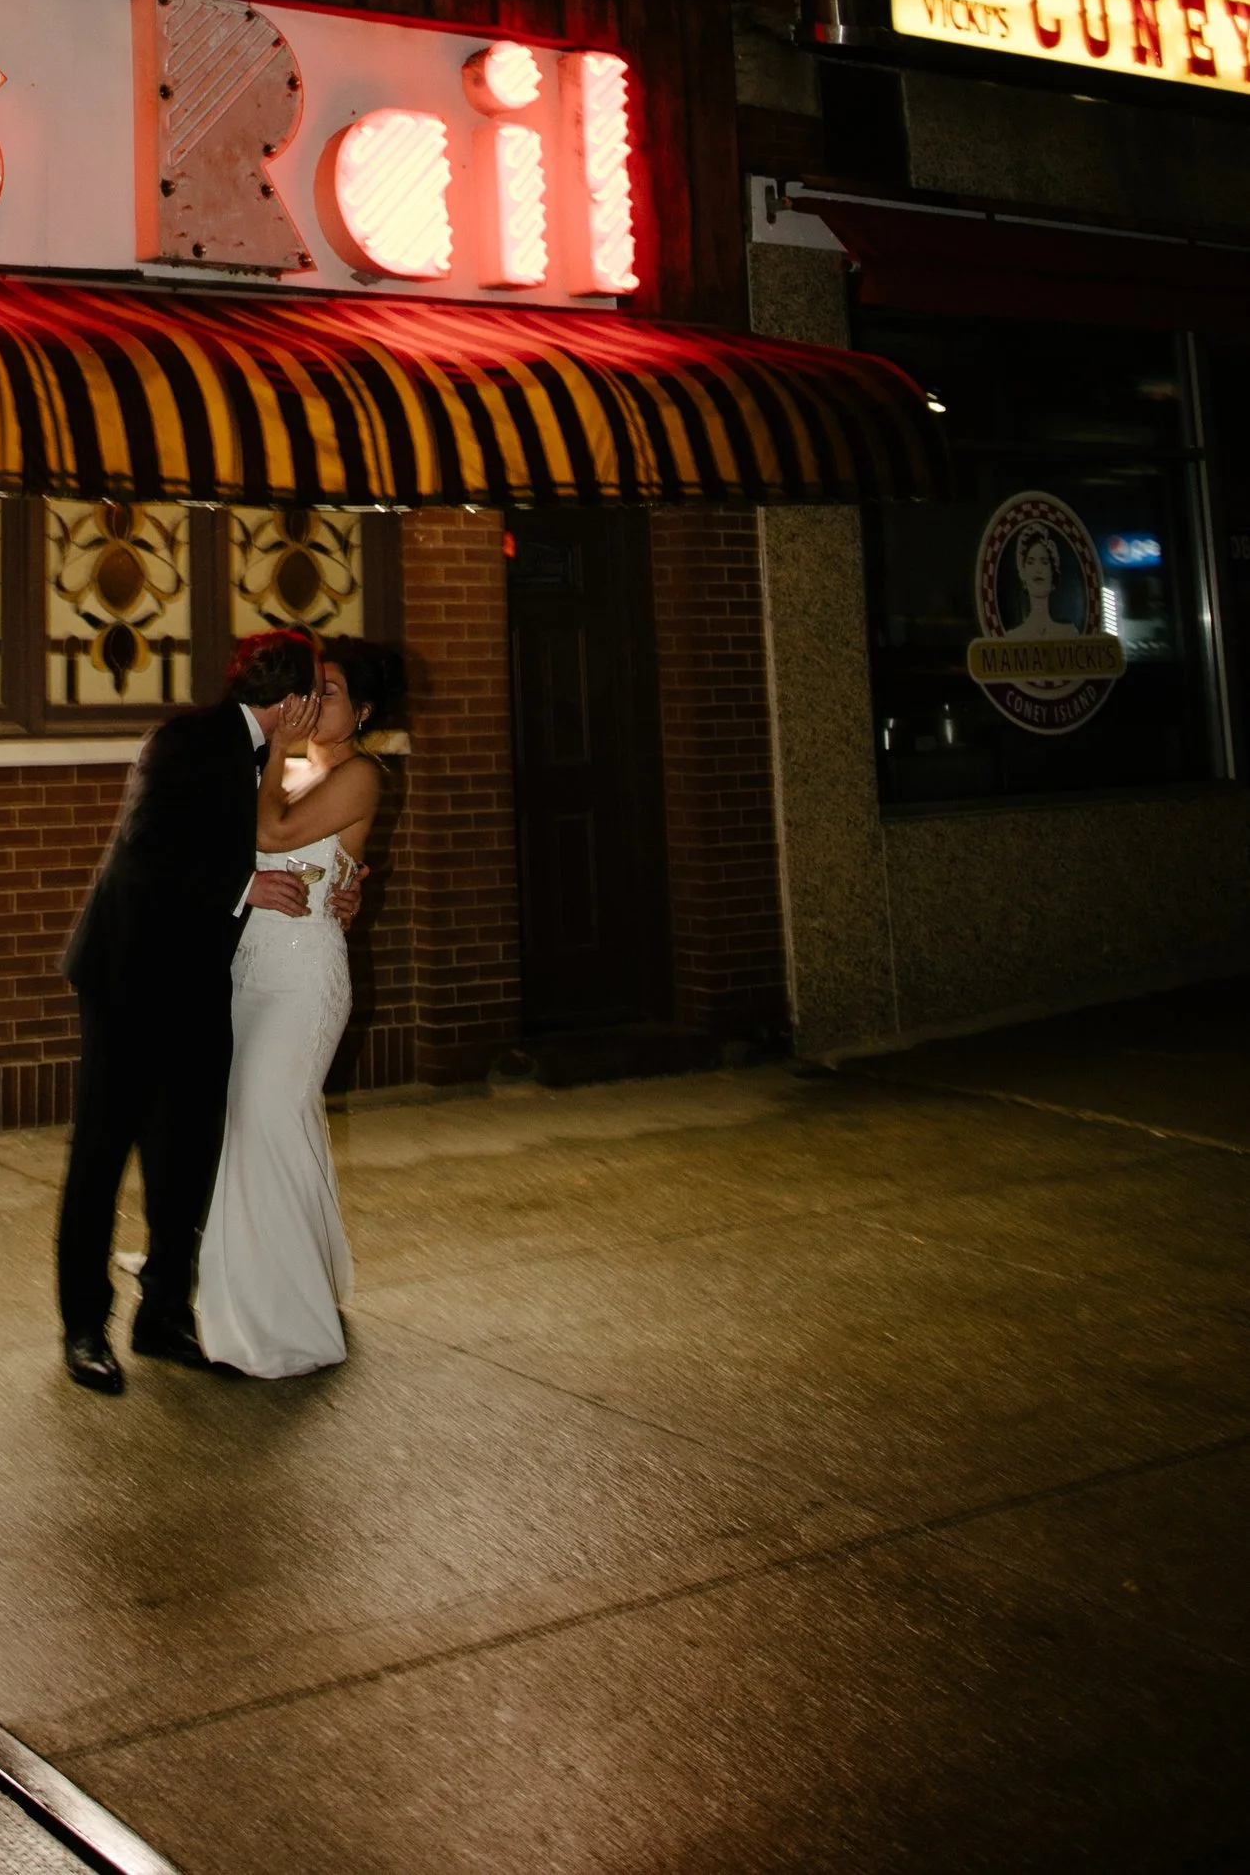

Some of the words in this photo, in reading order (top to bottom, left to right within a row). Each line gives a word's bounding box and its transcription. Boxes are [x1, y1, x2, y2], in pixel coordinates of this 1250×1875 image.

[1056, 644, 1116, 671] VICKI'S
[1005, 689, 1049, 724] CONEY
[1053, 684, 1098, 724] ISLAND
